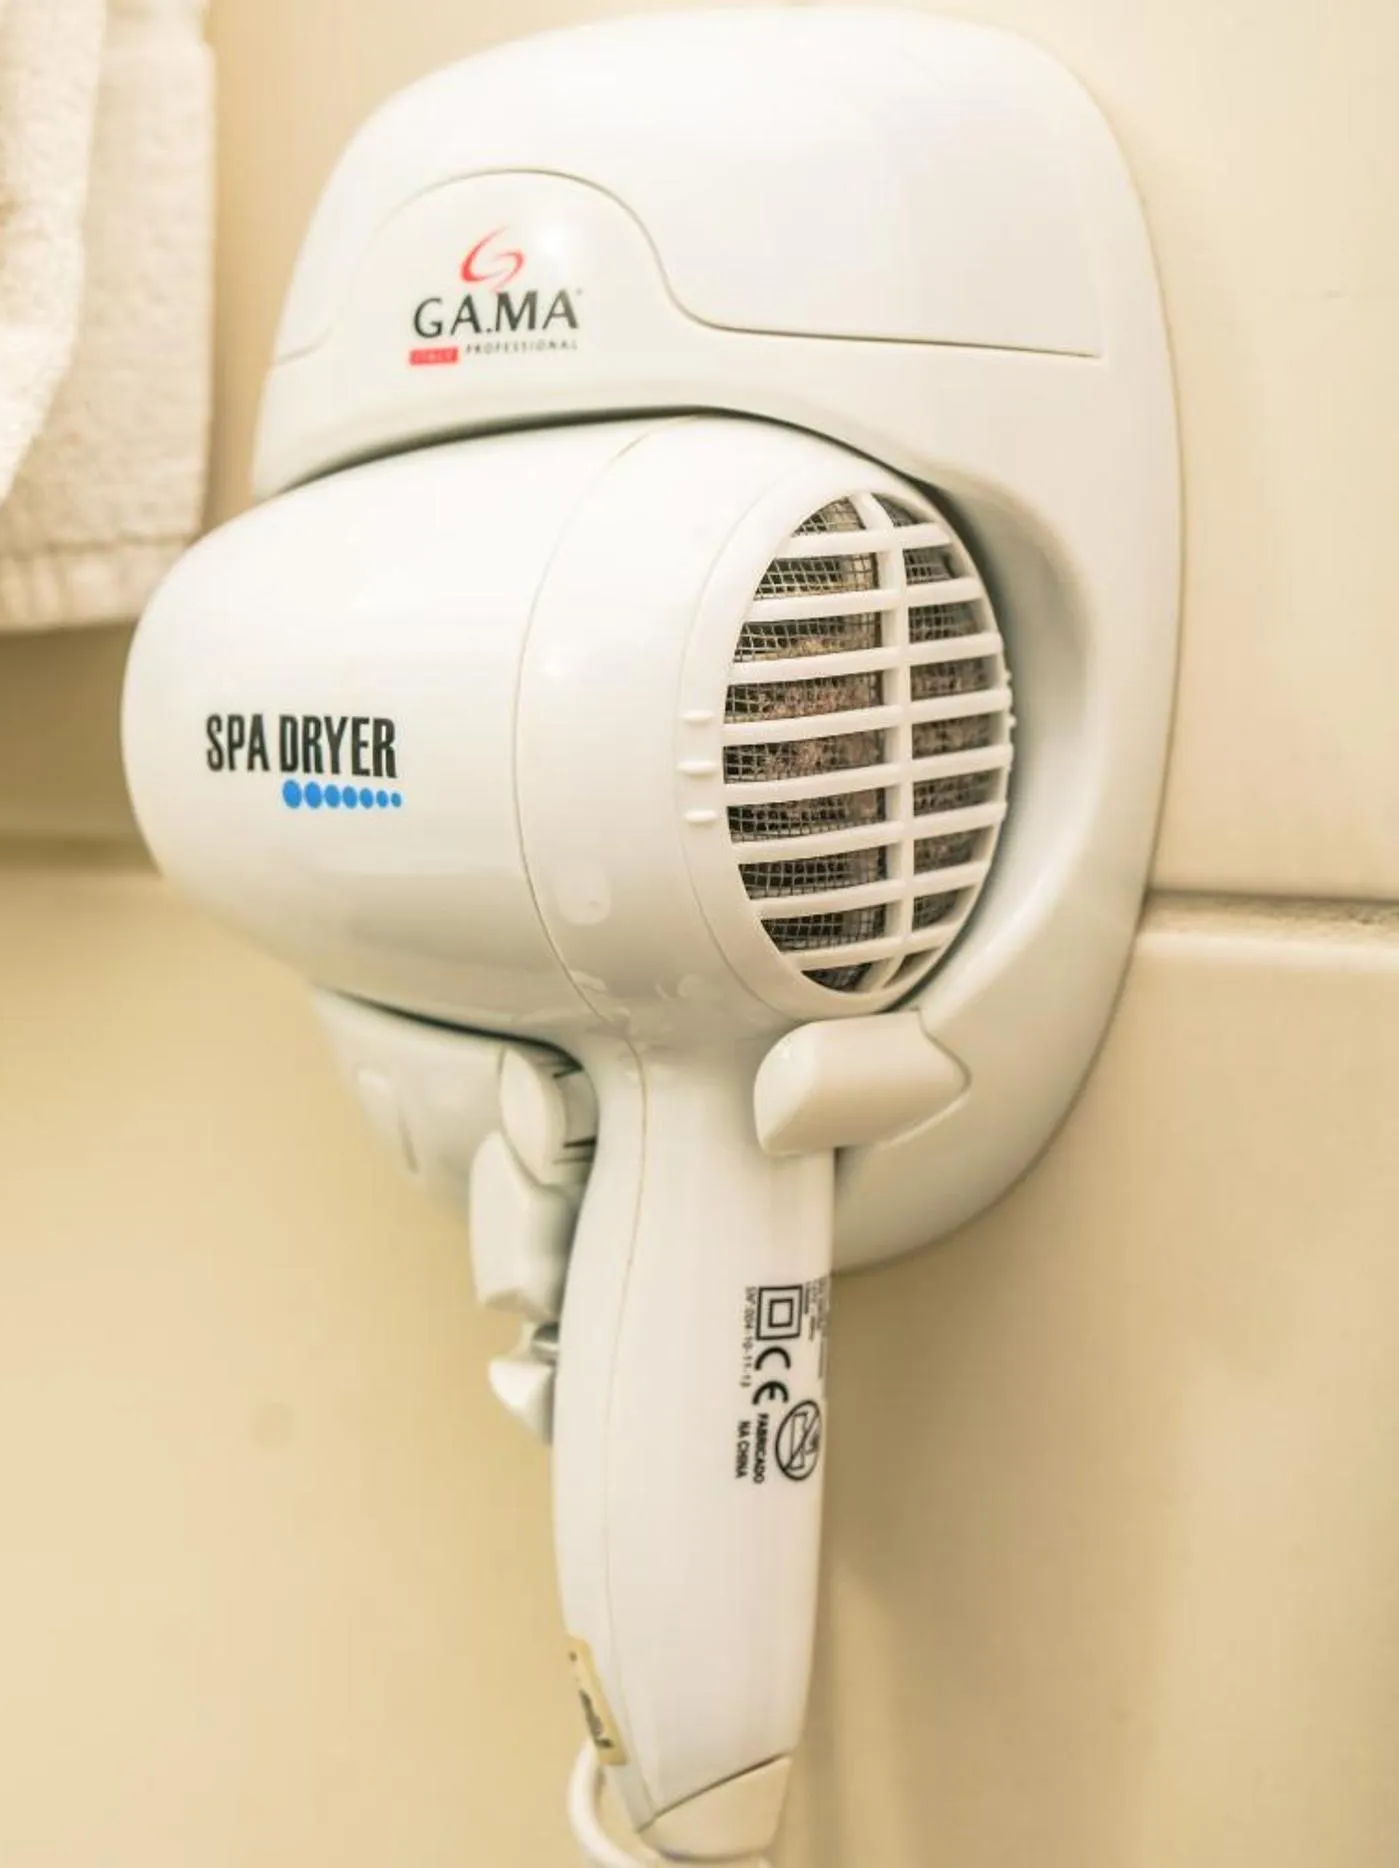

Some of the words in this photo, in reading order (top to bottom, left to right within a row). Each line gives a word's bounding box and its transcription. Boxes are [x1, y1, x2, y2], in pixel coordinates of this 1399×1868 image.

[413, 288, 579, 339] GA.MA
[206, 713, 270, 772] SPA
[279, 714, 398, 778] DRYER
[738, 1420, 751, 1438] NA
[753, 1413, 769, 1484] FABRICADO
[736, 1440, 751, 1479] CHINA
